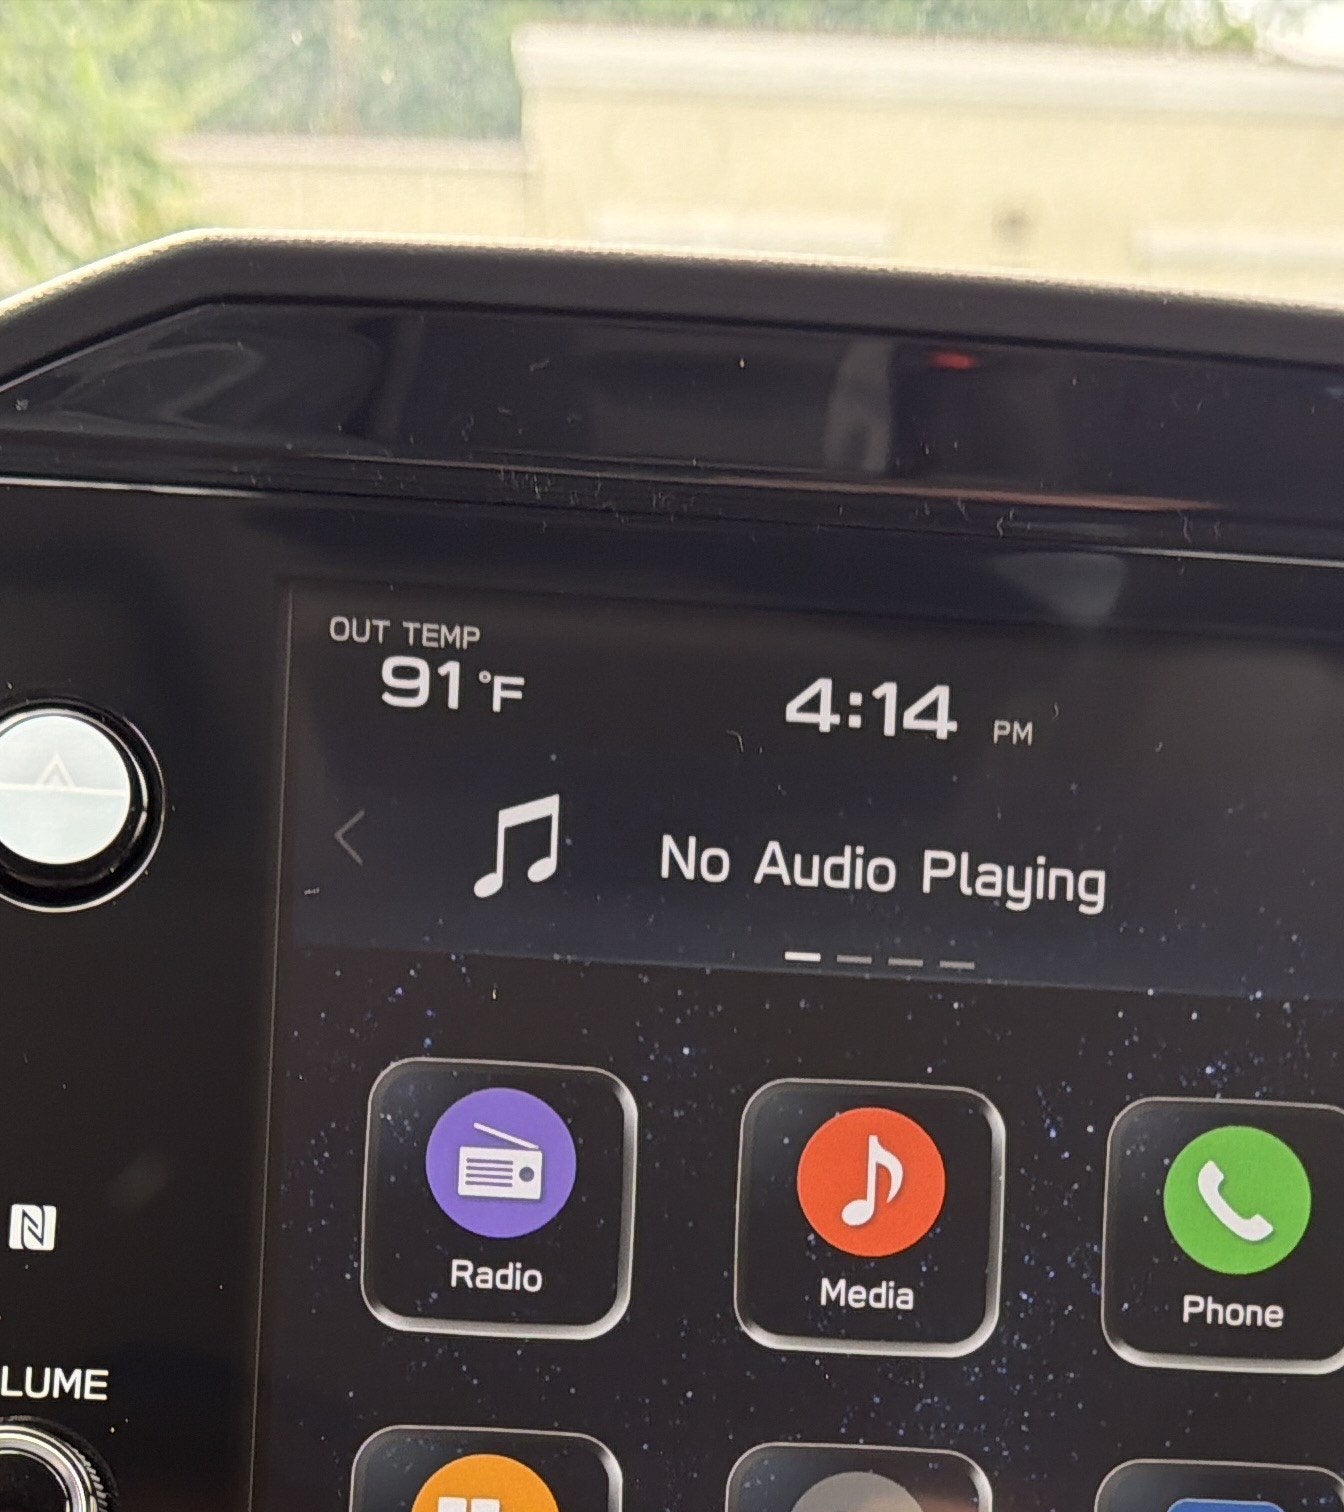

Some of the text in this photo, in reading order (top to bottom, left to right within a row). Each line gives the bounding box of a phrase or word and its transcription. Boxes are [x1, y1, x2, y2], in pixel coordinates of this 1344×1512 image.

[329, 616, 480, 649] OUT TEMP
[784, 677, 1033, 747] 4:14 PM
[660, 834, 1106, 914] No Audio Playing
[451, 1259, 542, 1292] Radio
[820, 1278, 914, 1310] Media
[1182, 1295, 1284, 1328] Phone
